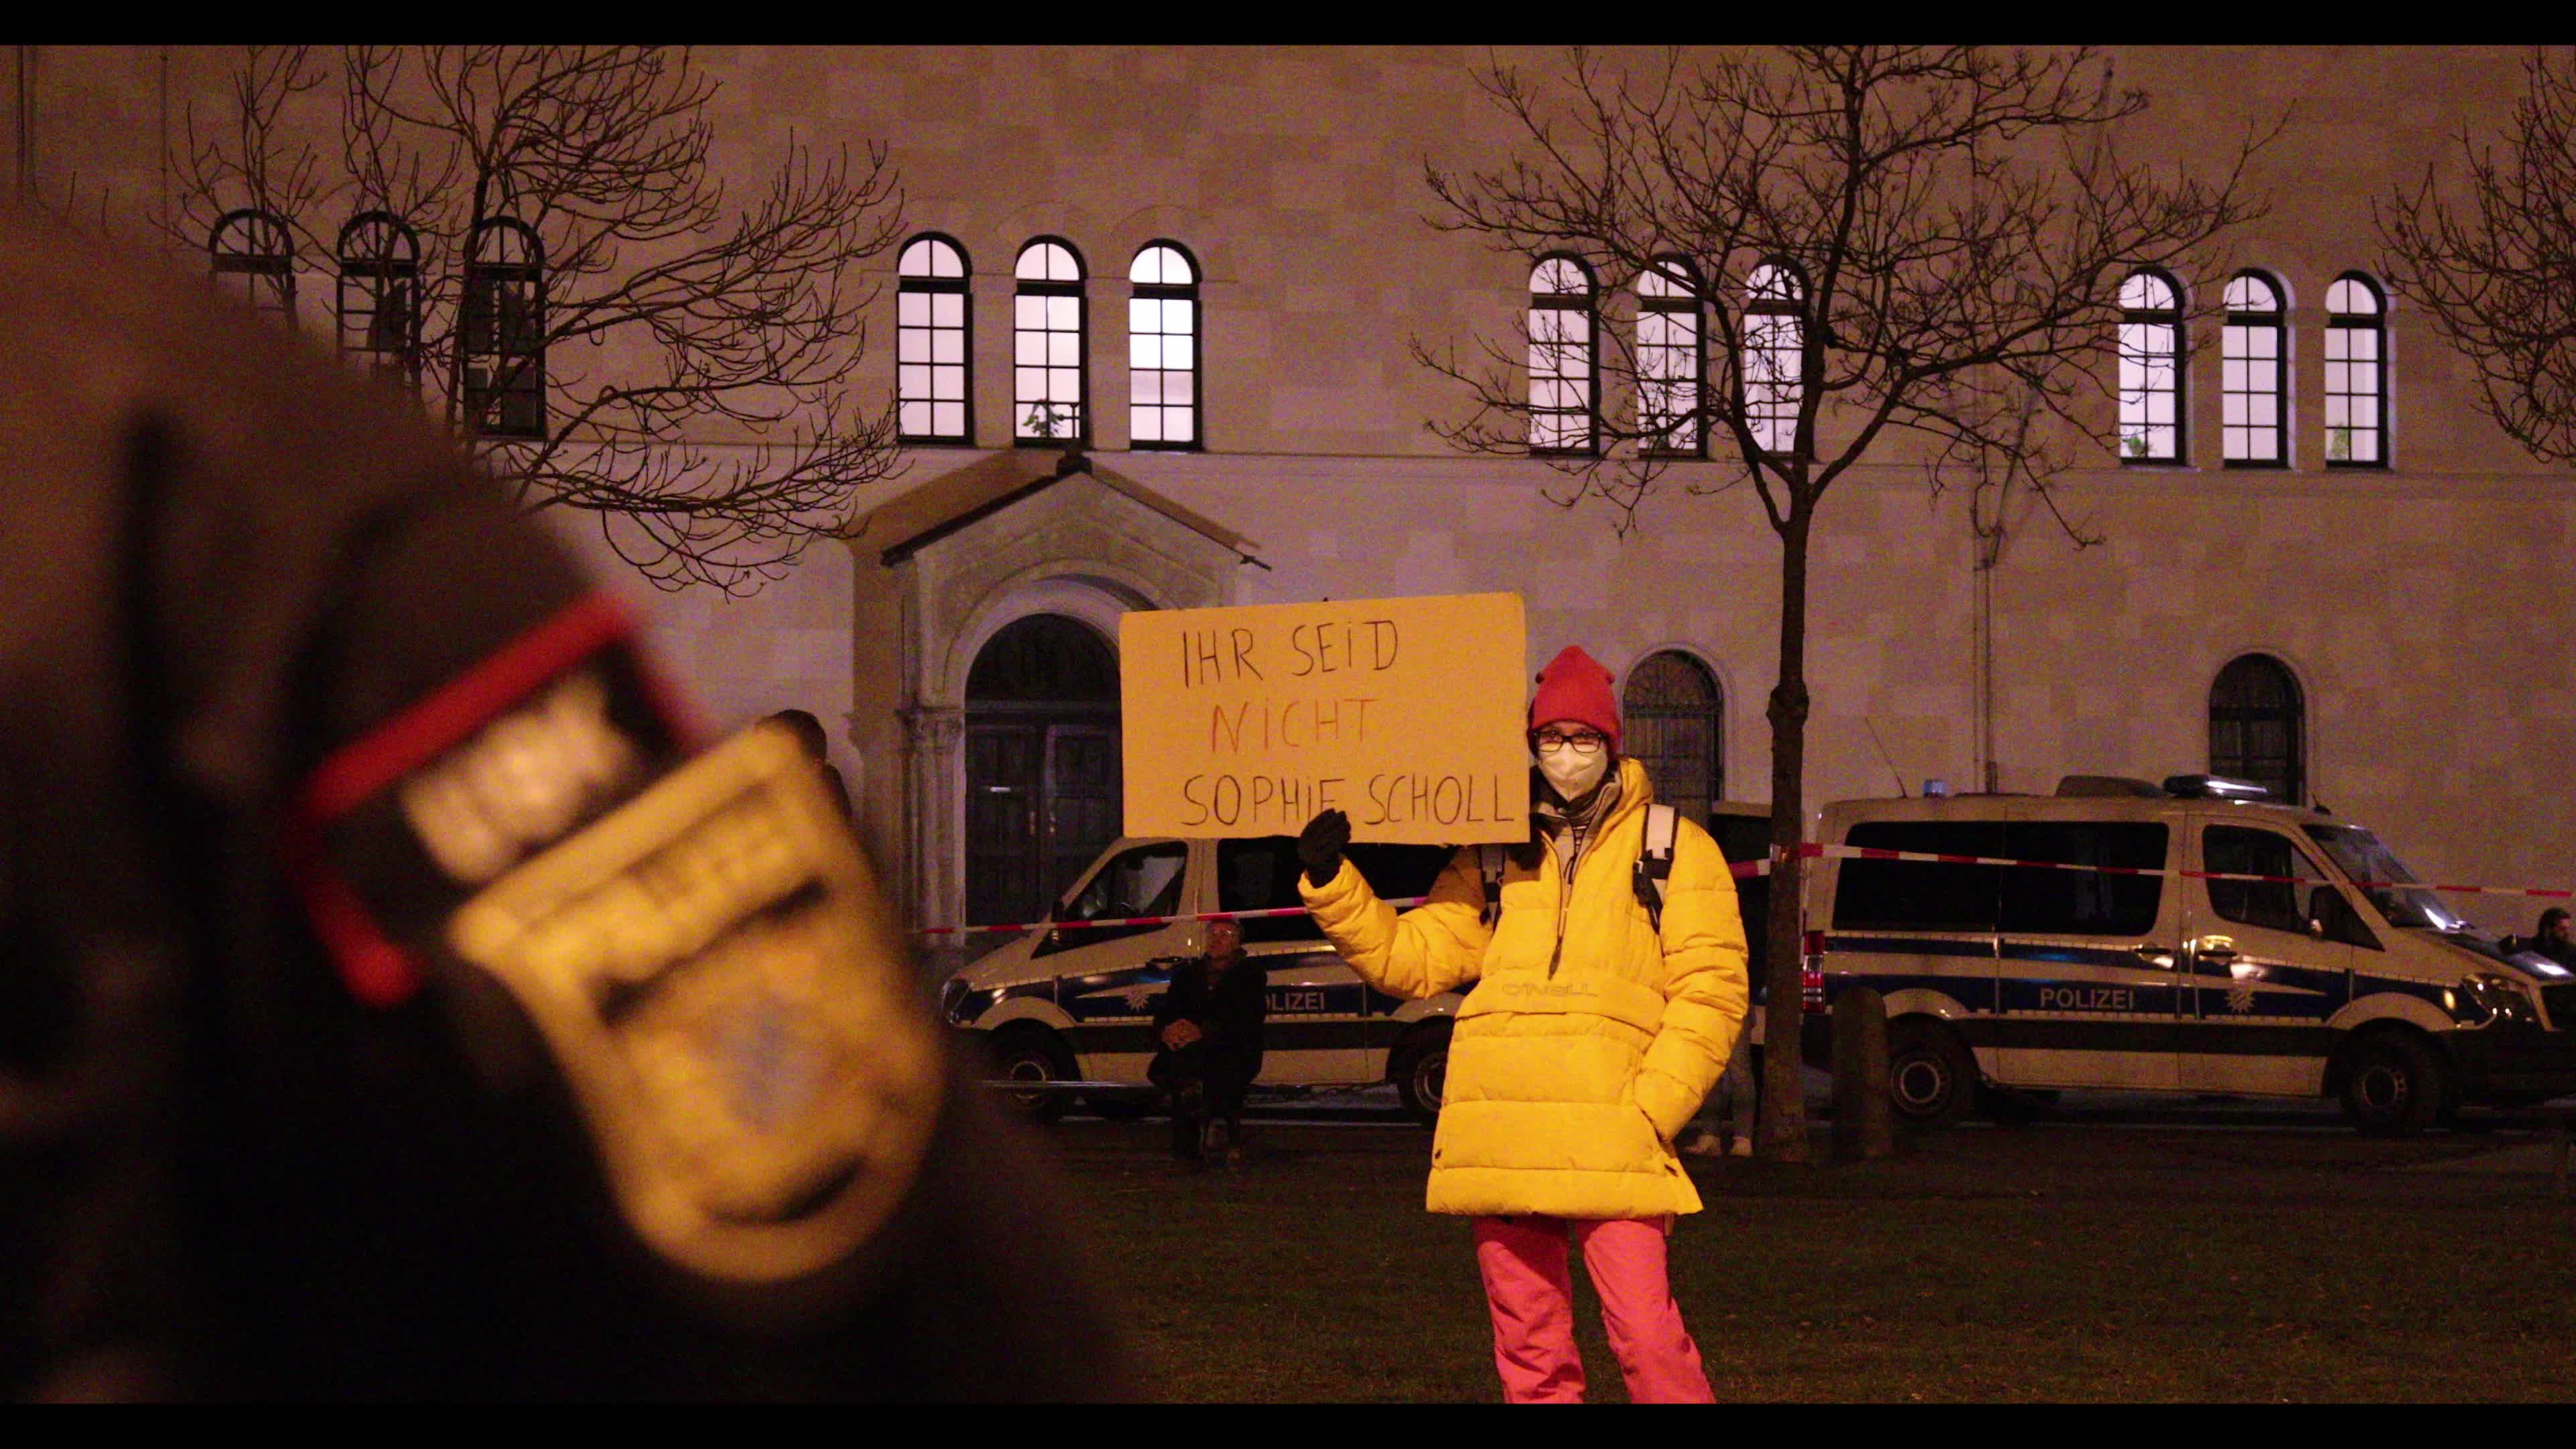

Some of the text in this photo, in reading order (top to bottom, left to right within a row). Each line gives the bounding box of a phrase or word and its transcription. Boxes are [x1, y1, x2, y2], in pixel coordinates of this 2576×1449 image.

[1183, 628, 1263, 689] IHR
[1364, 774, 1514, 825] SCHOLL
[2039, 987, 2134, 1010] POLIZEI
